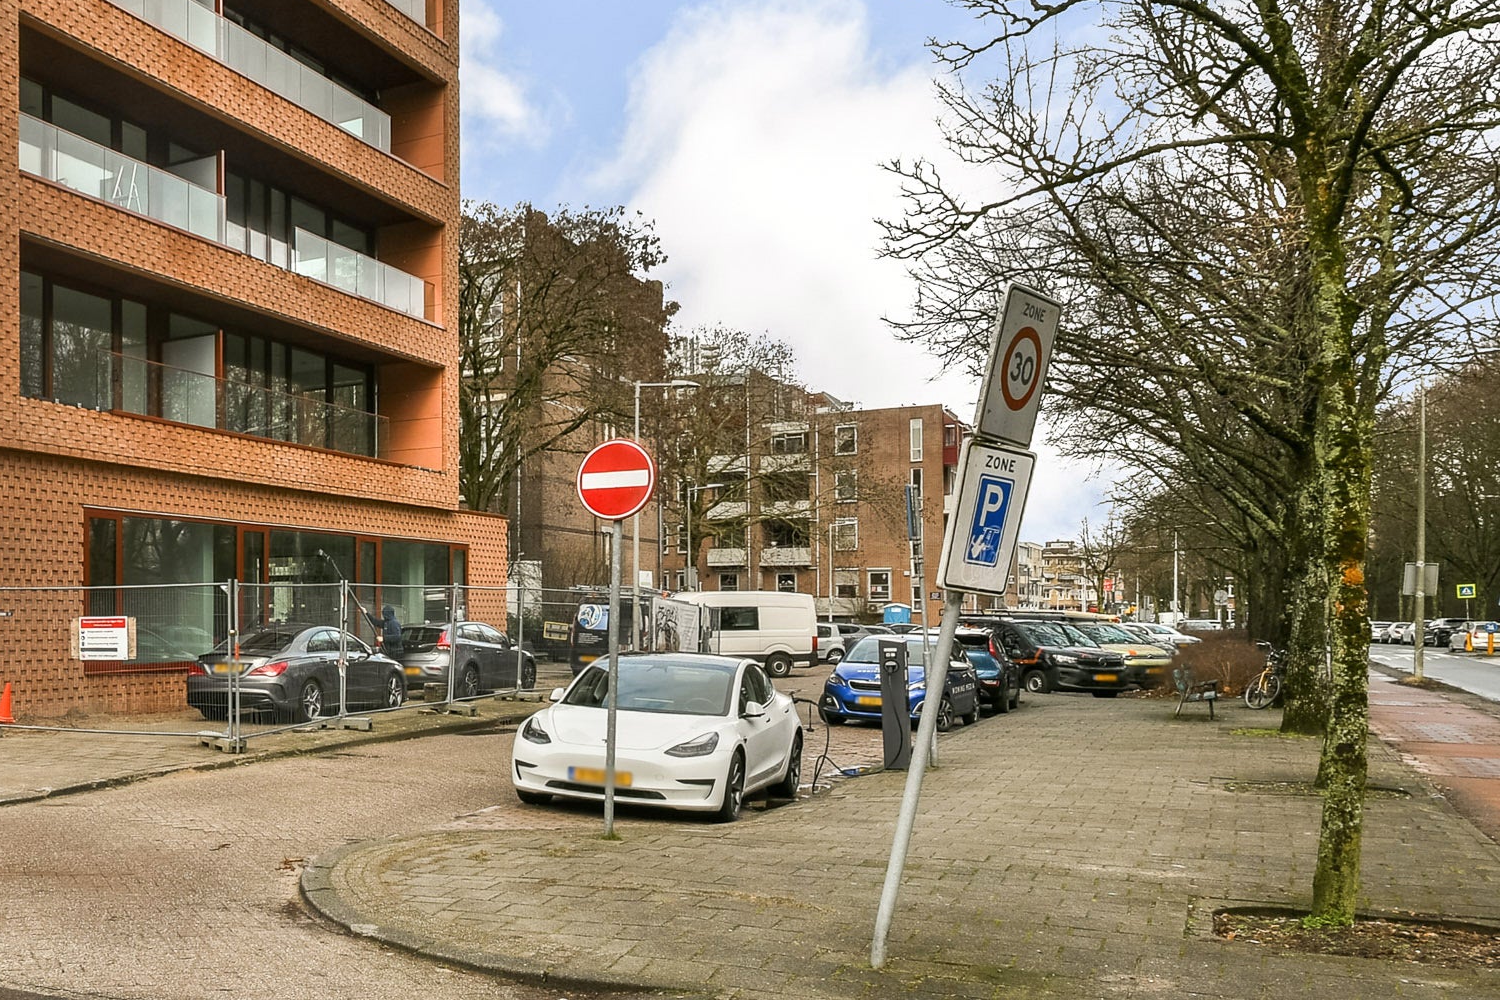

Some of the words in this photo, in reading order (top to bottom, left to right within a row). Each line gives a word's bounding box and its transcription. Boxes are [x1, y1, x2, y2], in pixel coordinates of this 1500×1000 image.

[1023, 302, 1047, 323] ZONE
[1010, 351, 1034, 386] 30
[985, 455, 1016, 473] ZONE
[979, 483, 1004, 527] P
